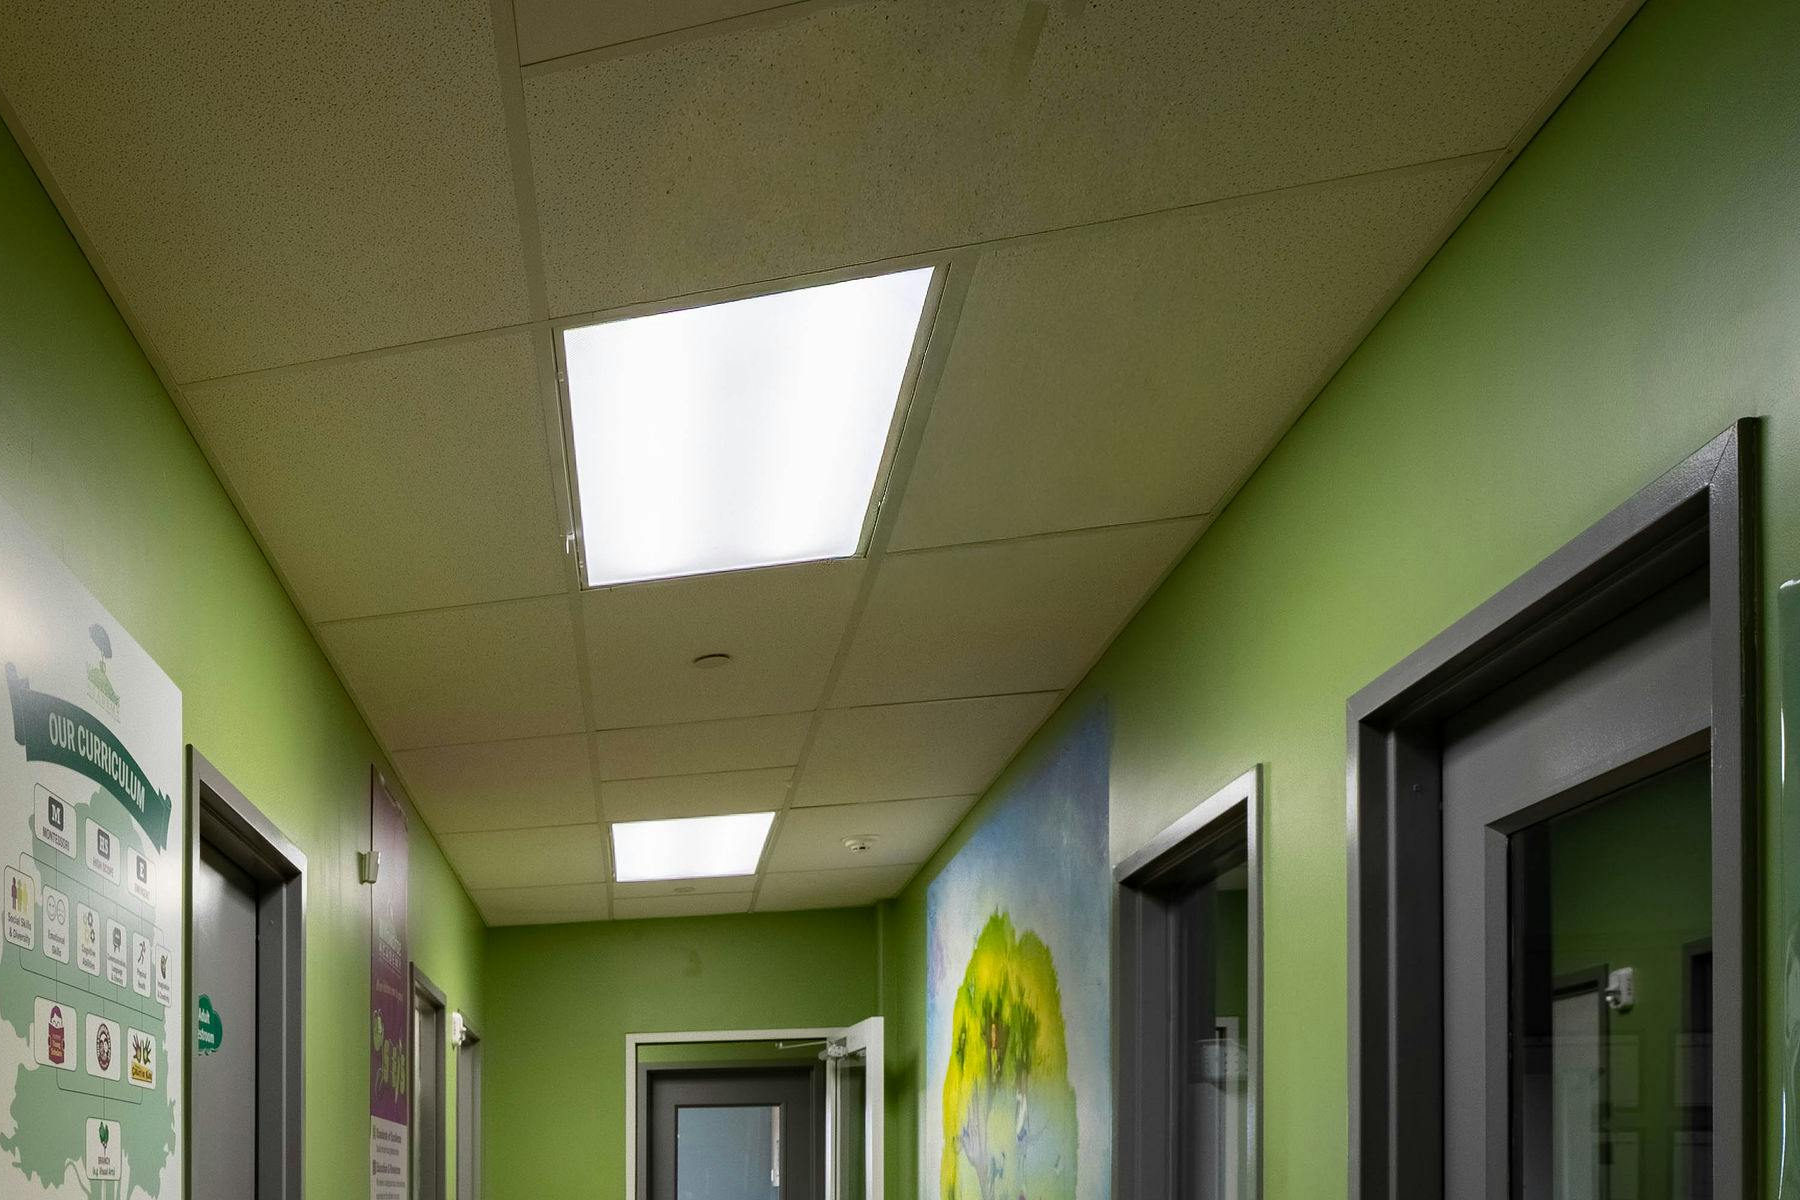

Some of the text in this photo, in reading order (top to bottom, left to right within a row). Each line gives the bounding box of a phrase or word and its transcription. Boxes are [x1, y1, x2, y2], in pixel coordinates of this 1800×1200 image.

[48, 711, 146, 813] OUR CURRICULUM
[52, 803, 61, 825] M
[43, 826, 70, 852] MONTESSORI
[8, 912, 32, 930] Social Skills
[12, 932, 31, 946] Diversity
